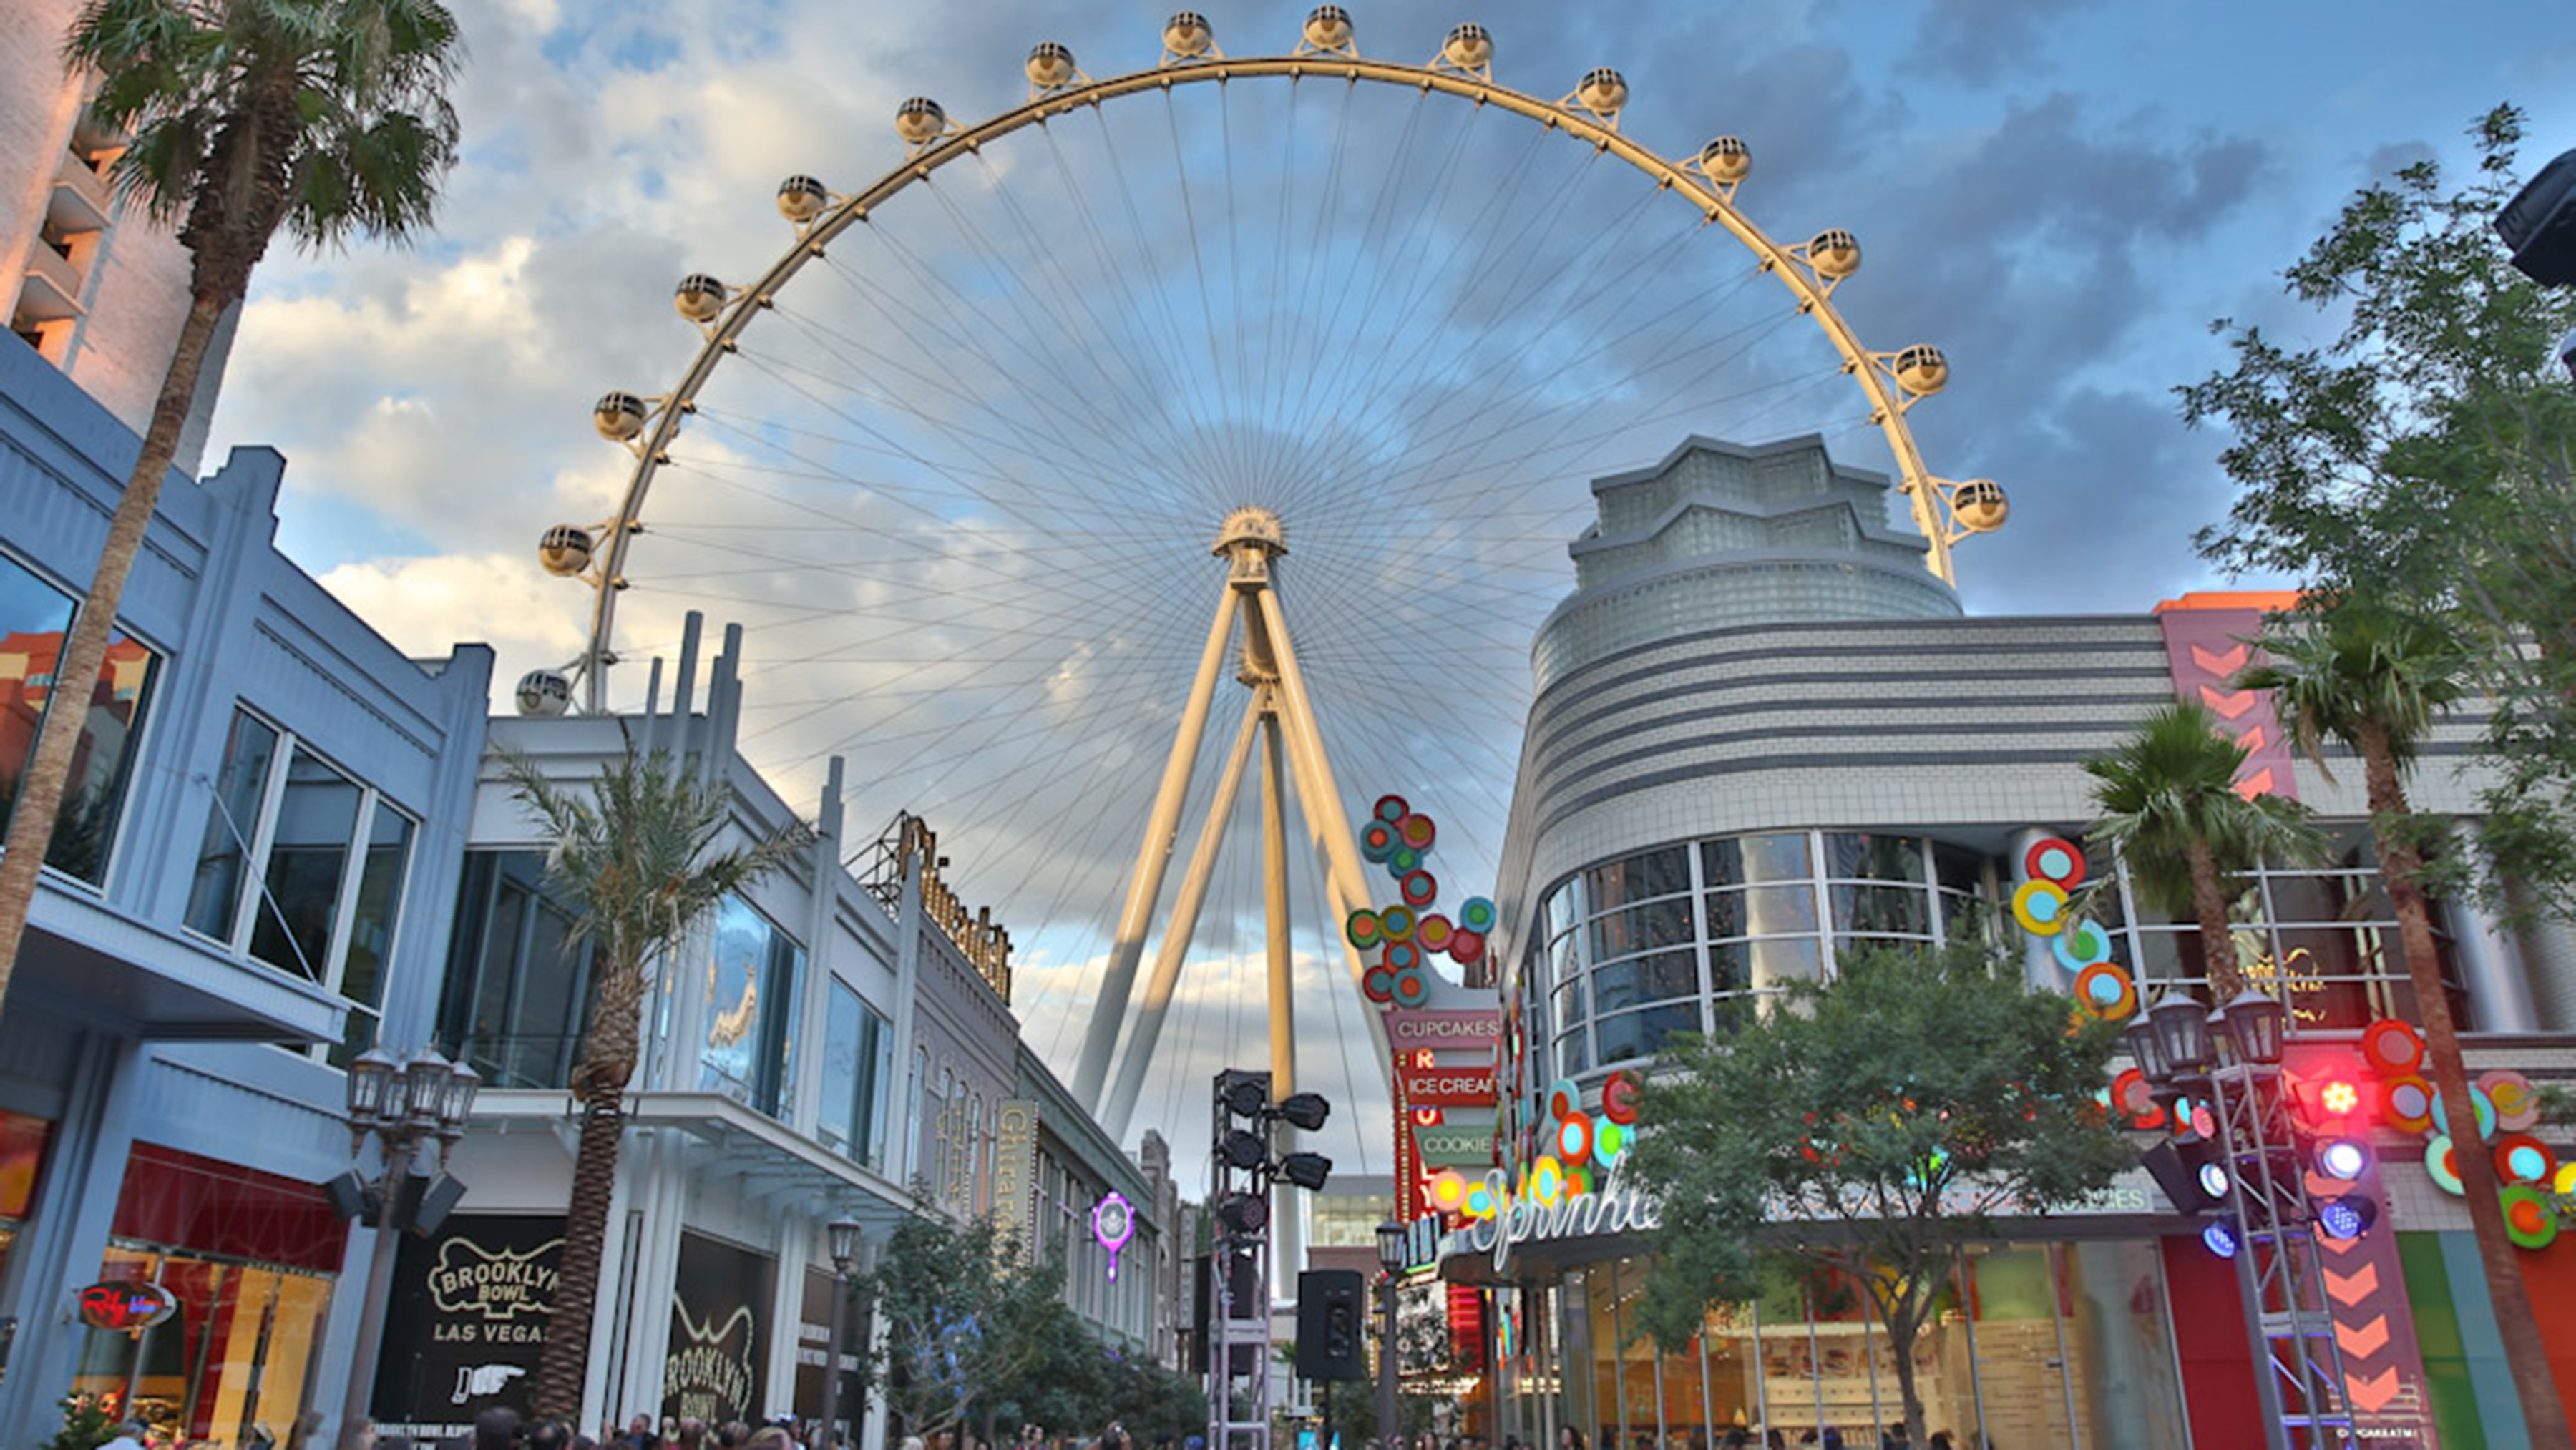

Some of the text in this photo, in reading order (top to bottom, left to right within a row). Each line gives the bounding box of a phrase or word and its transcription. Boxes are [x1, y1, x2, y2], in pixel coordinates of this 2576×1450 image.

[1397, 1020, 1498, 1037] CUPCAKES
[1409, 1078, 1438, 1094] ICE
[477, 1285, 531, 1302] BOWL
[434, 1324, 550, 1343] LAS VEGA
[663, 1346, 746, 1413] ROOKLYN
